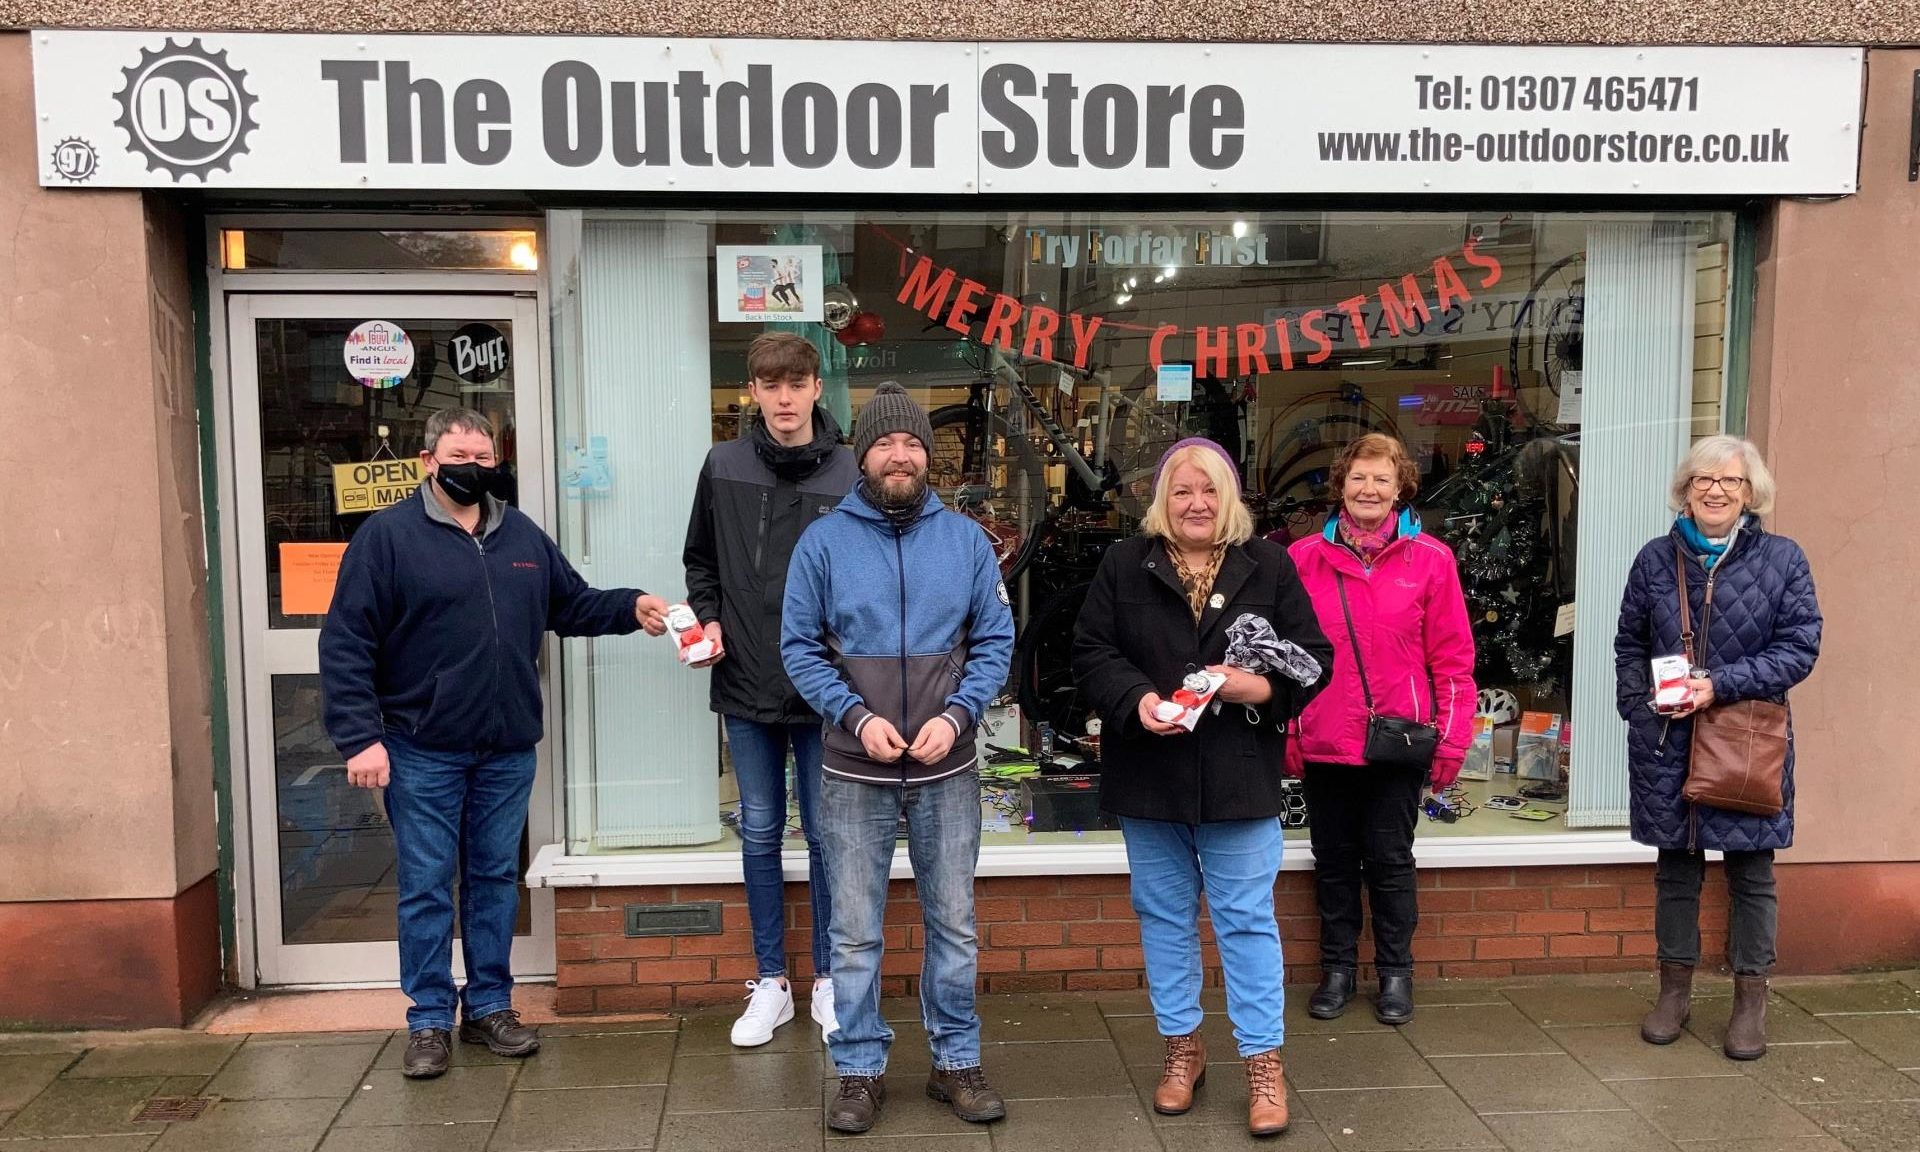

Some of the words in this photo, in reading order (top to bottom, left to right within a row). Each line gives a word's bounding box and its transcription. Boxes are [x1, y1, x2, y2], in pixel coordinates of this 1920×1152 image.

[139, 76, 234, 143] OS
[1415, 75, 1472, 110] Tel:
[1480, 75, 1576, 111] 01307
[1583, 76, 1698, 112] 465471
[321, 60, 512, 165] The
[541, 60, 949, 169] Outdoor
[981, 63, 1245, 170] Store
[60, 147, 89, 173] 97
[1317, 127, 1790, 163] www.the-outdoorstore.co.uk
[1026, 229, 1079, 268] Try
[897, 256, 1103, 368] MERRY
[1150, 240, 1502, 379] CHRISTMAS
[371, 334, 386, 344] BUY
[350, 355, 371, 364] Find
[373, 356, 380, 364] it
[383, 355, 408, 364] local
[353, 462, 418, 484] OPEN
